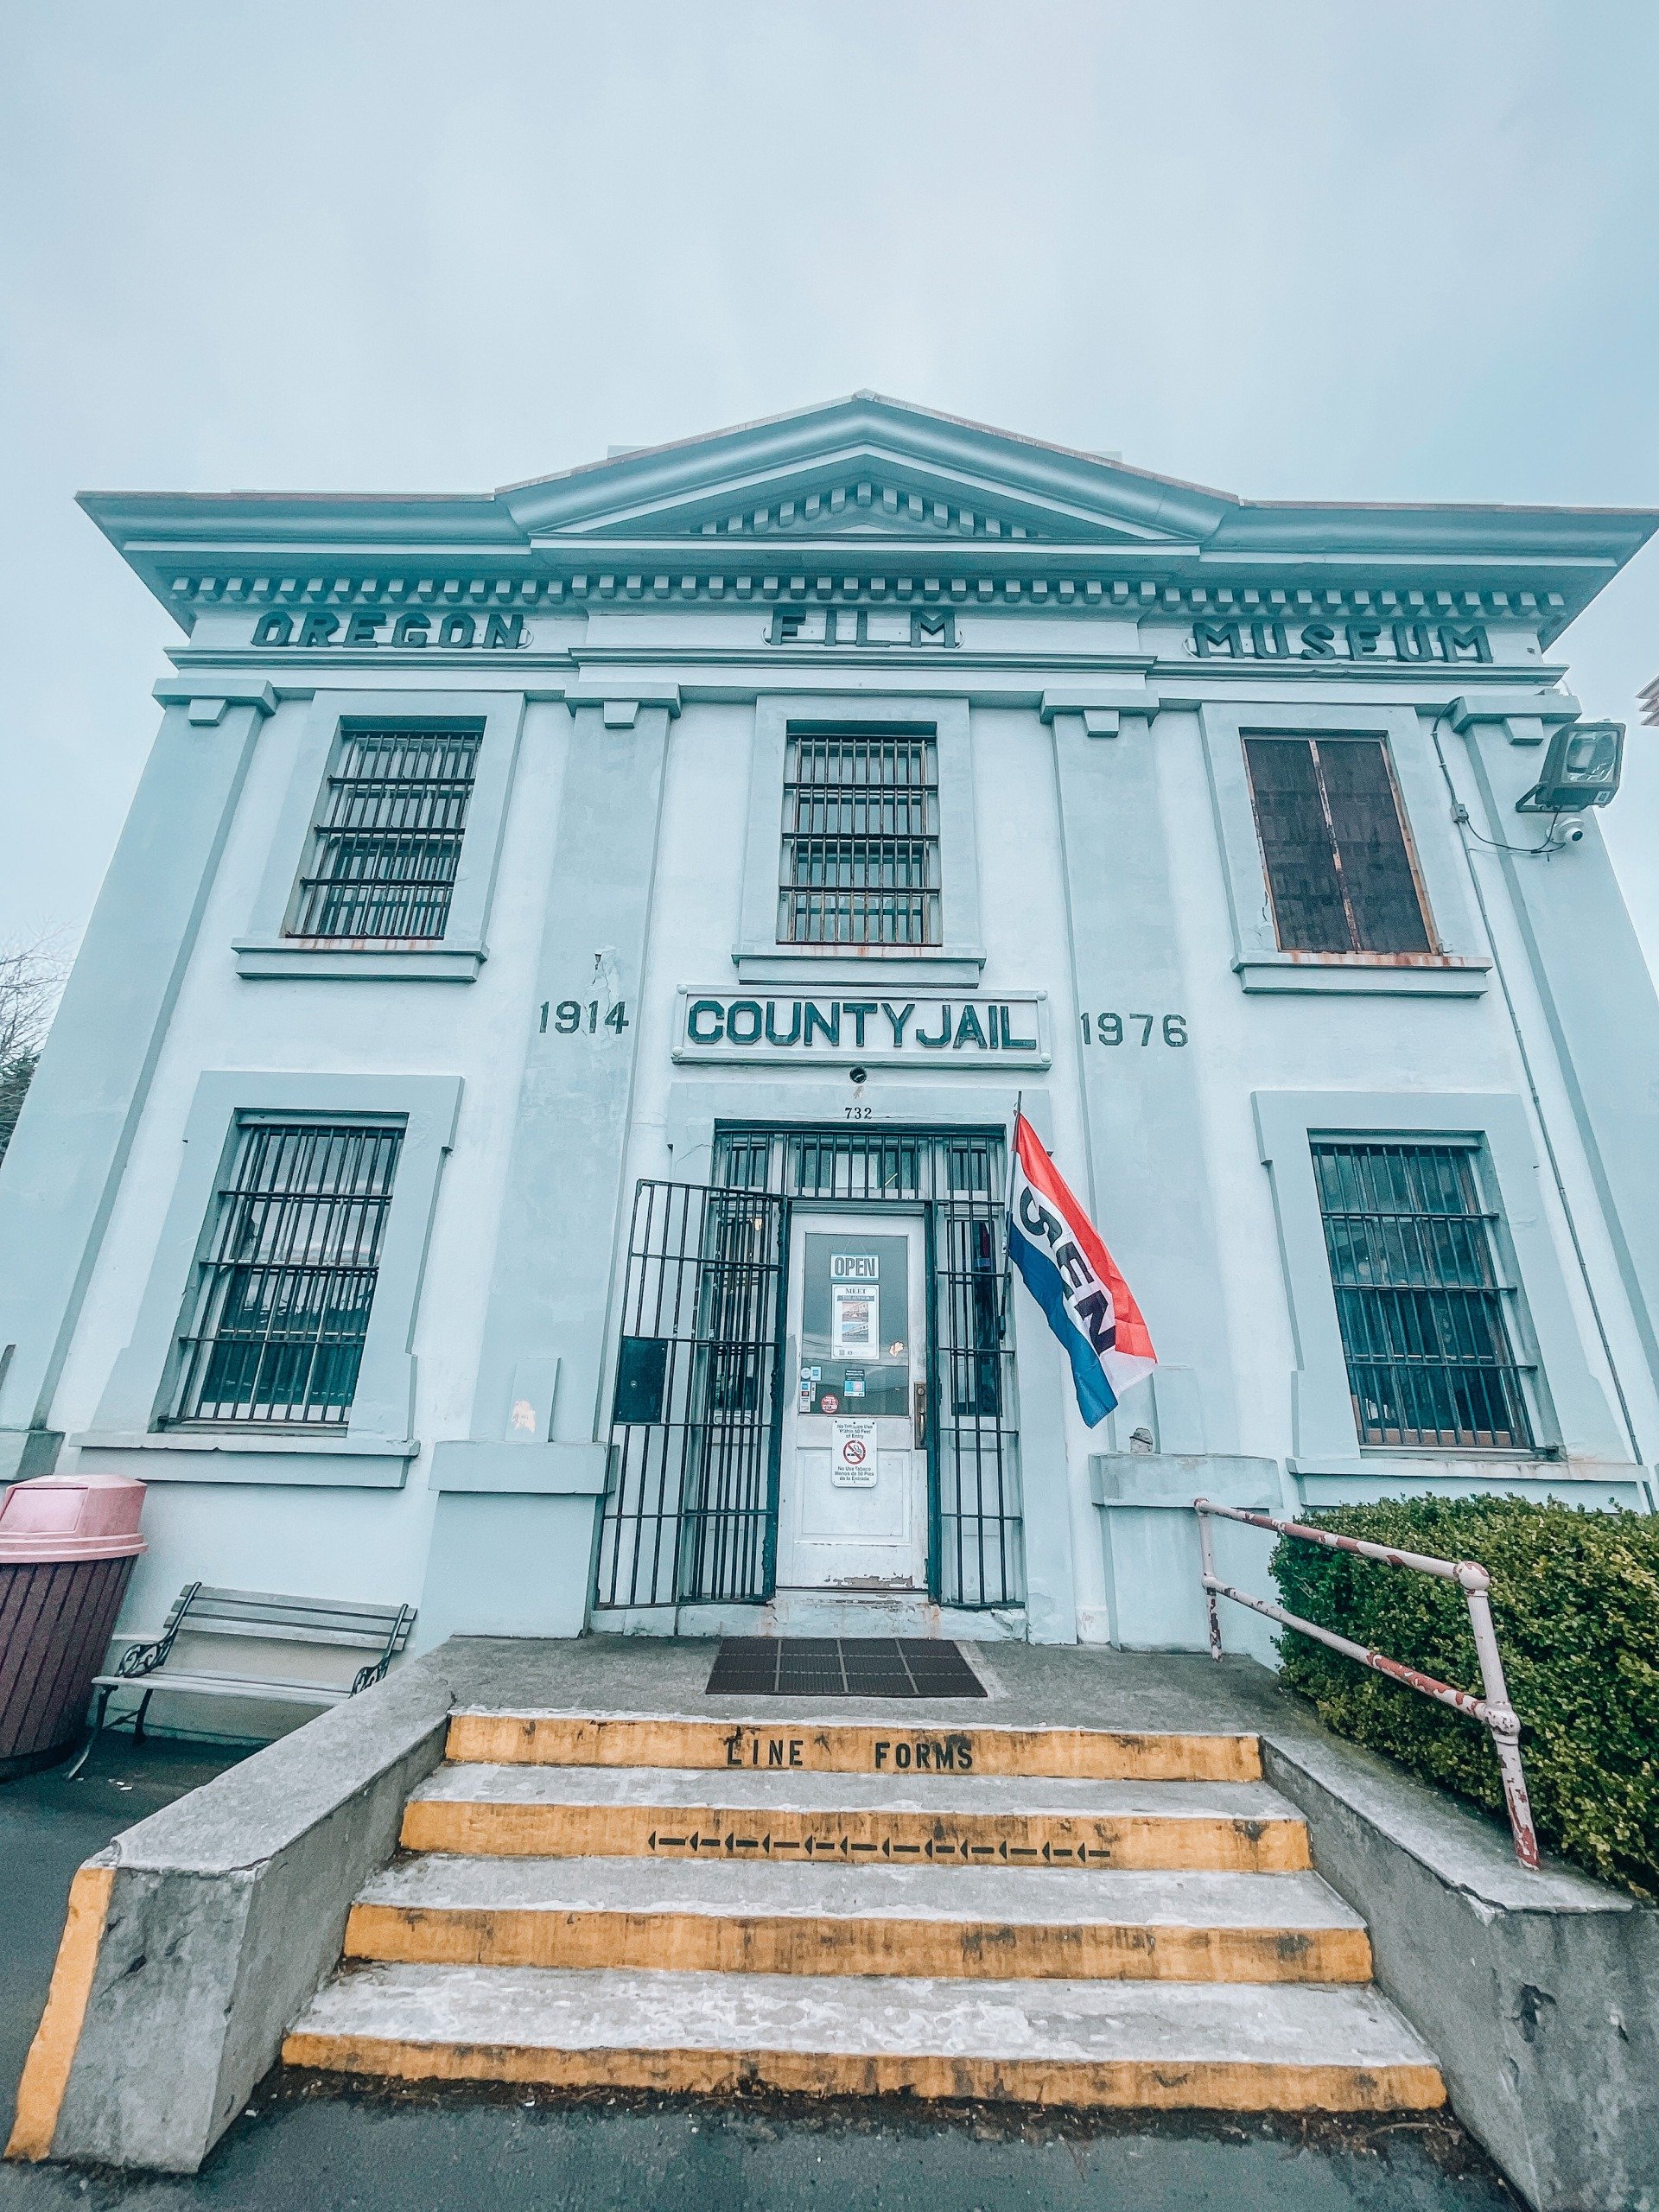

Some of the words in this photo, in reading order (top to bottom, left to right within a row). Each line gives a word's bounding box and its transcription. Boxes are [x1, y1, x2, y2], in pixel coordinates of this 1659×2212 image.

[252, 611, 524, 649] OREGON
[771, 607, 956, 647] FILM
[1192, 622, 1493, 663] MUSEUM
[539, 1000, 629, 1034] 1914
[688, 1000, 916, 1047] COUNTY
[916, 1004, 1037, 1050] JAIL
[1080, 1012, 1188, 1047] 1976
[844, 1107, 872, 1120] 732
[835, 1256, 875, 1276] OPEN
[727, 1738, 804, 1765] LINE
[875, 1740, 972, 1770] FORMS
